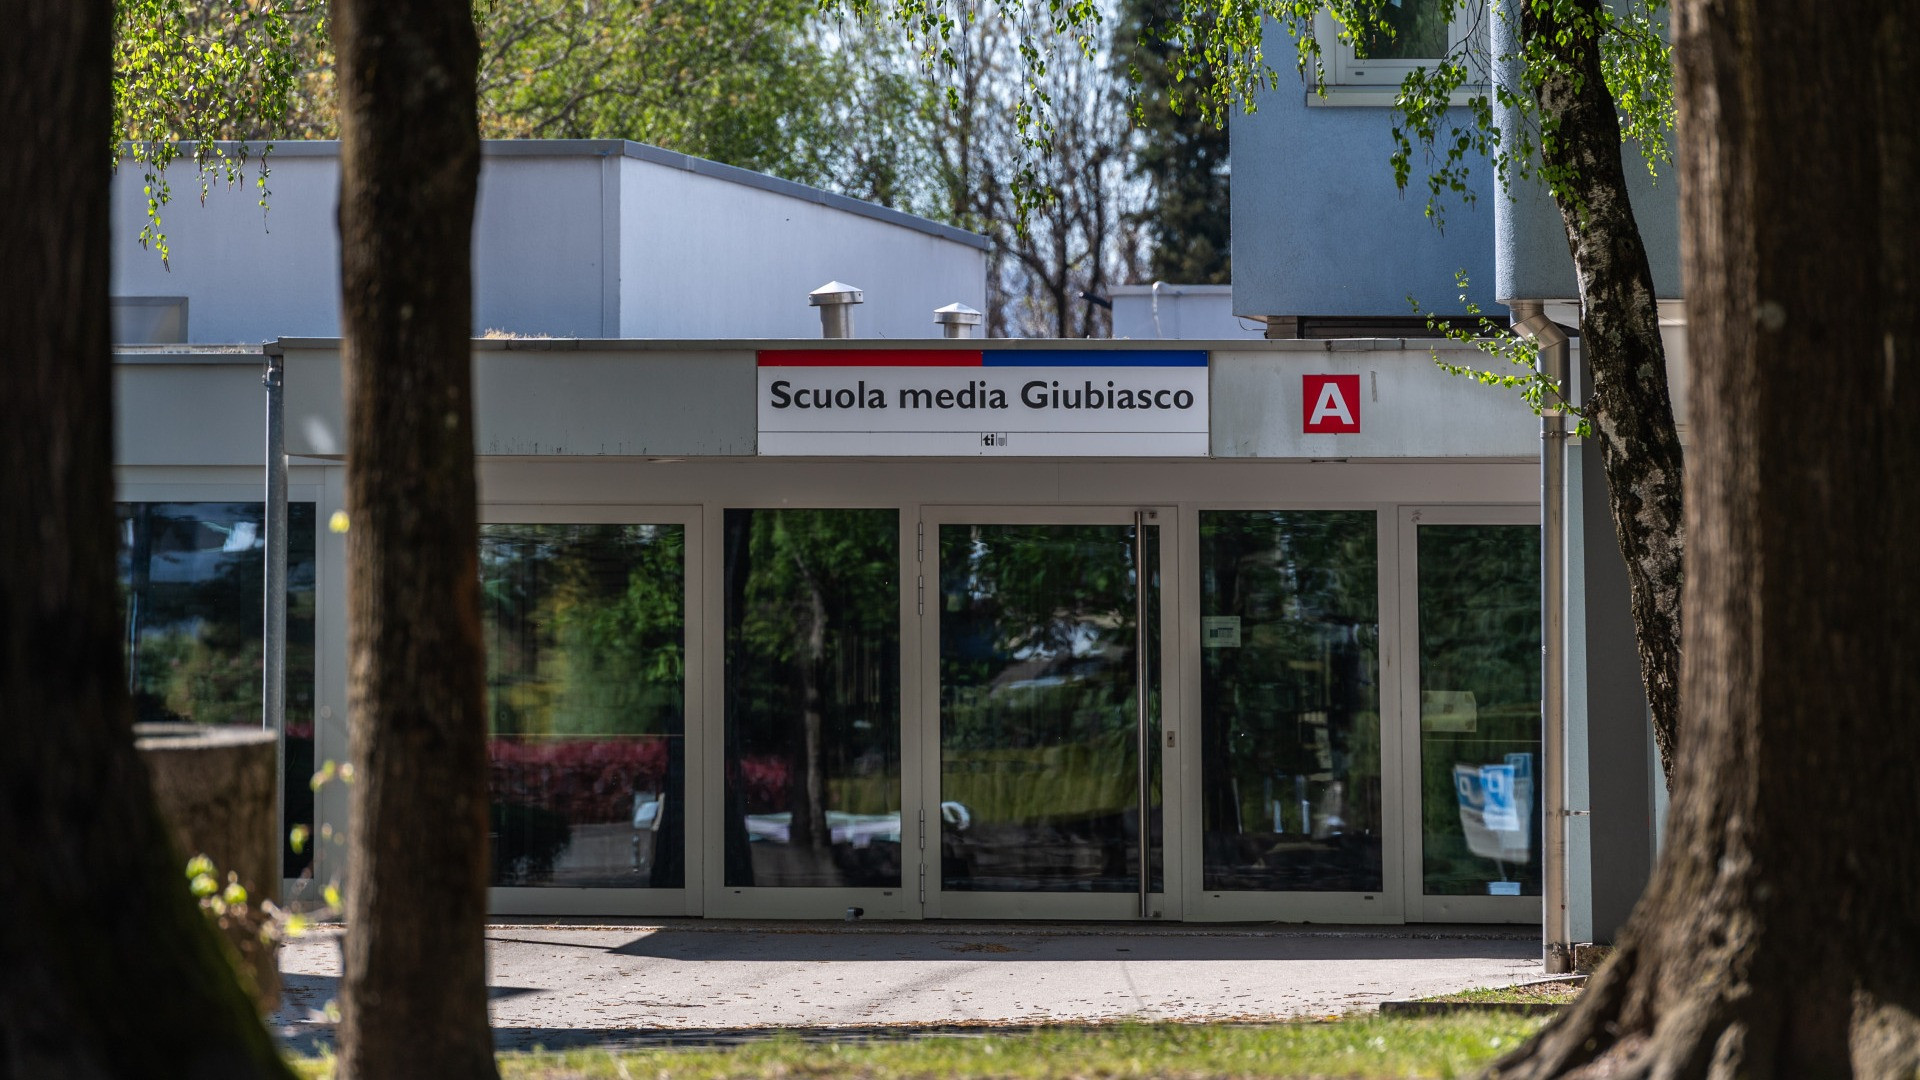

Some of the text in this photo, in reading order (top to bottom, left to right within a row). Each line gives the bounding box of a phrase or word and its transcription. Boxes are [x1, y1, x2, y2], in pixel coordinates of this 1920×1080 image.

[770, 379, 1194, 410] Scuola media Giubiasco
[1309, 382, 1355, 425] A
[982, 433, 995, 446] ti
